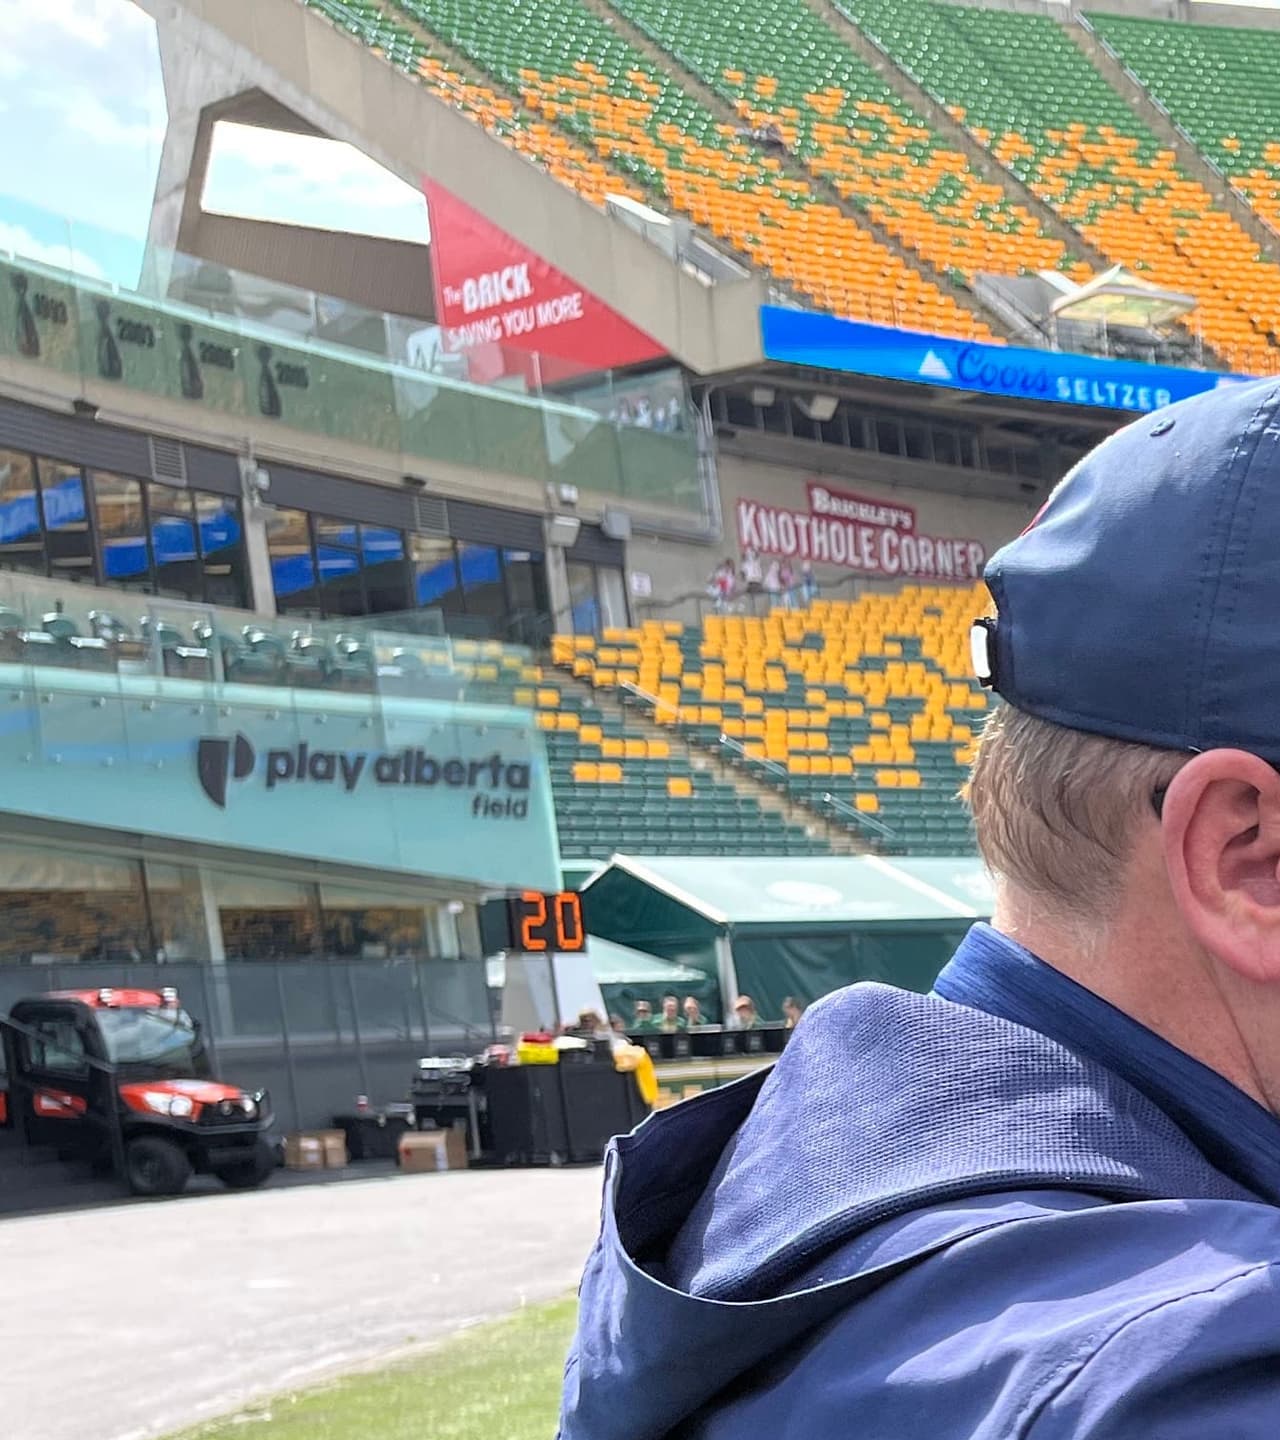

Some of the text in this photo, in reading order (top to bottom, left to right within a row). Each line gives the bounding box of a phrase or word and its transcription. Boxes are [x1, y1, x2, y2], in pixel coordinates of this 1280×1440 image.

[443, 262, 533, 314] The BRICK
[448, 292, 584, 352] SAVING YOU MORE
[1056, 375, 1172, 410] SELTZER
[738, 502, 984, 578] KNOTHOLE CORNER
[266, 742, 531, 791] play alberta
[472, 794, 528, 819] field
[521, 892, 584, 951] 20
